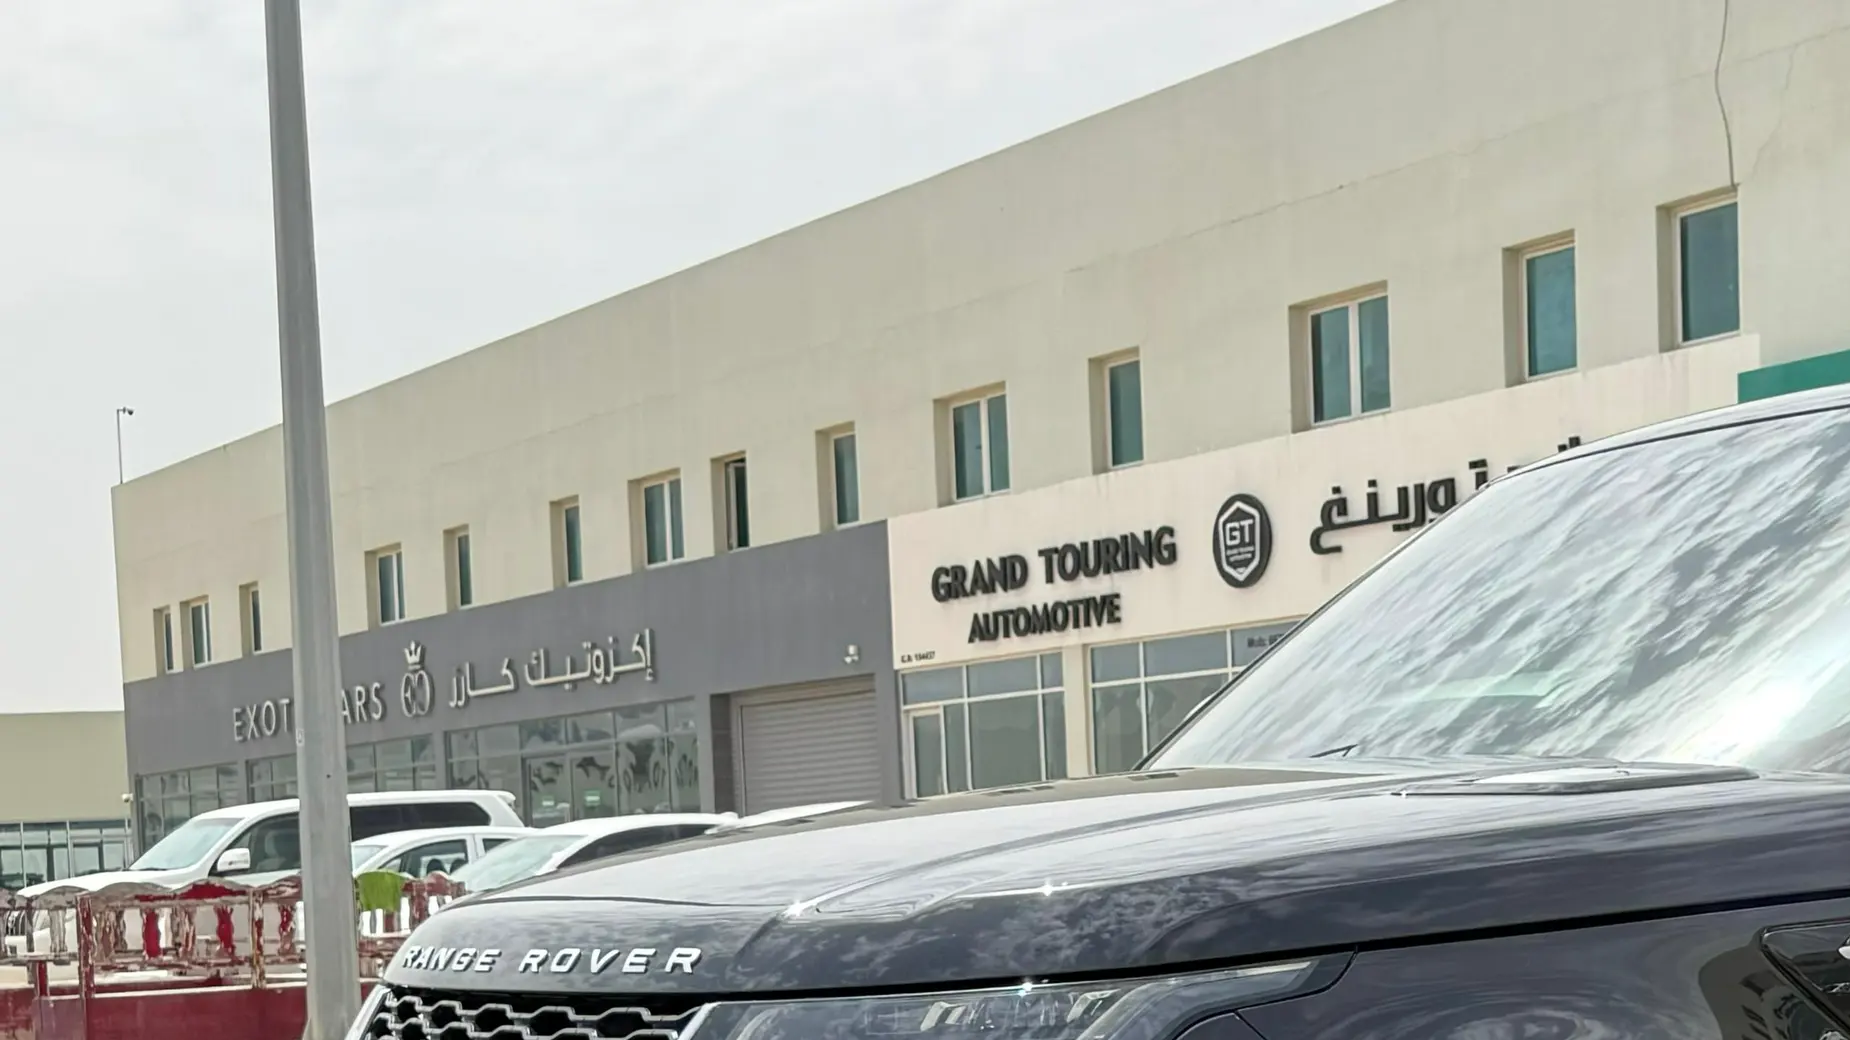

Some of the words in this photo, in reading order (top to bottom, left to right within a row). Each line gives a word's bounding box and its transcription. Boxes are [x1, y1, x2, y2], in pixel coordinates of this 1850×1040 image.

[1225, 519, 1254, 546] GT
[931, 555, 1029, 603] GRAND
[1038, 526, 1177, 584] TOURING
[968, 593, 1122, 643] AUTOMOTIVE
[449, 656, 518, 708] كارز
[524, 628, 656, 690] إكزوتيك
[232, 698, 291, 742] EXOT
[340, 682, 385, 724] ARS
[402, 946, 501, 973] RANGE
[518, 947, 702, 974] ROVER
